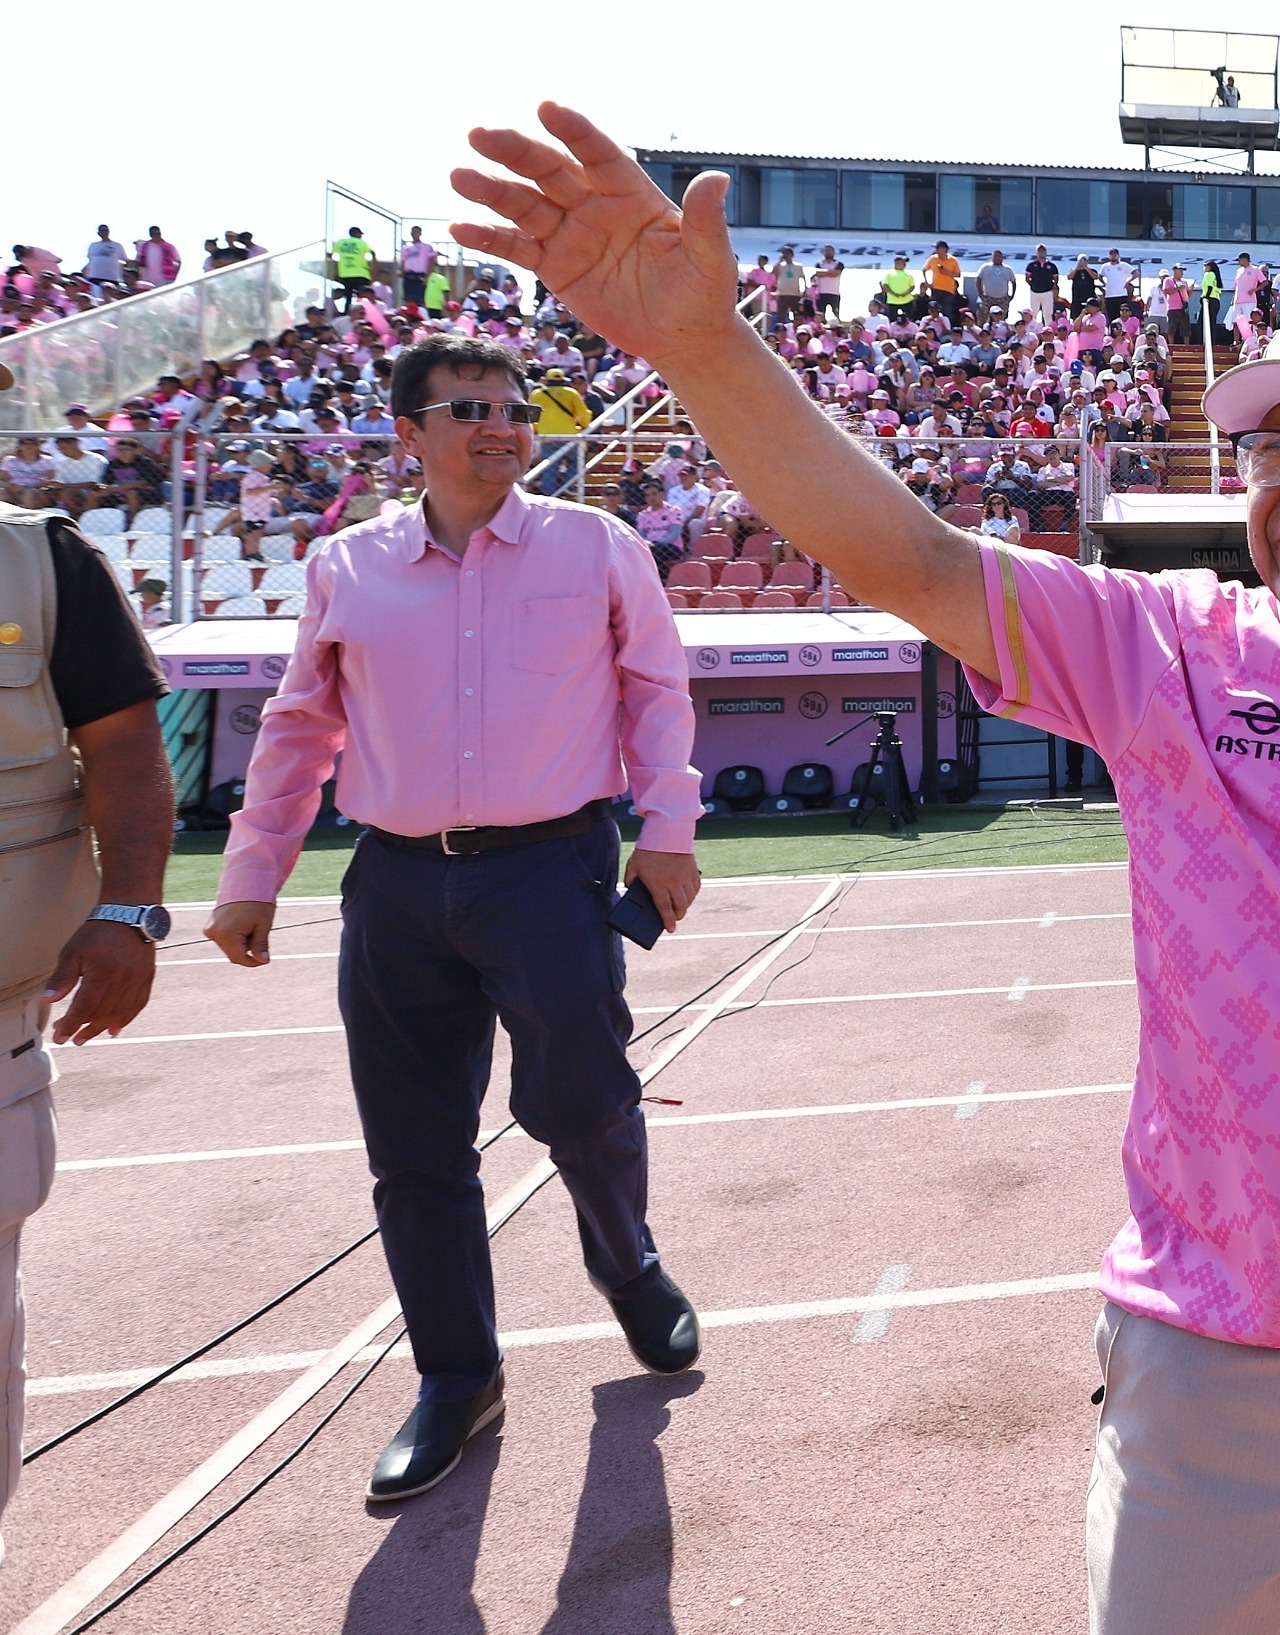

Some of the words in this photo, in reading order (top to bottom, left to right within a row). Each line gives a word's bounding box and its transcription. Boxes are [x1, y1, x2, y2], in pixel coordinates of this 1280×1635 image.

[1193, 551, 1239, 567] SALIDA
[700, 652, 715, 664] SBA
[732, 652, 787, 662] marathon
[803, 650, 817, 661] SBA
[834, 650, 887, 660] marathon
[902, 647, 916, 659] SBA
[711, 700, 782, 712] marathon
[803, 698, 822, 713] SBA
[844, 700, 913, 711] marathon
